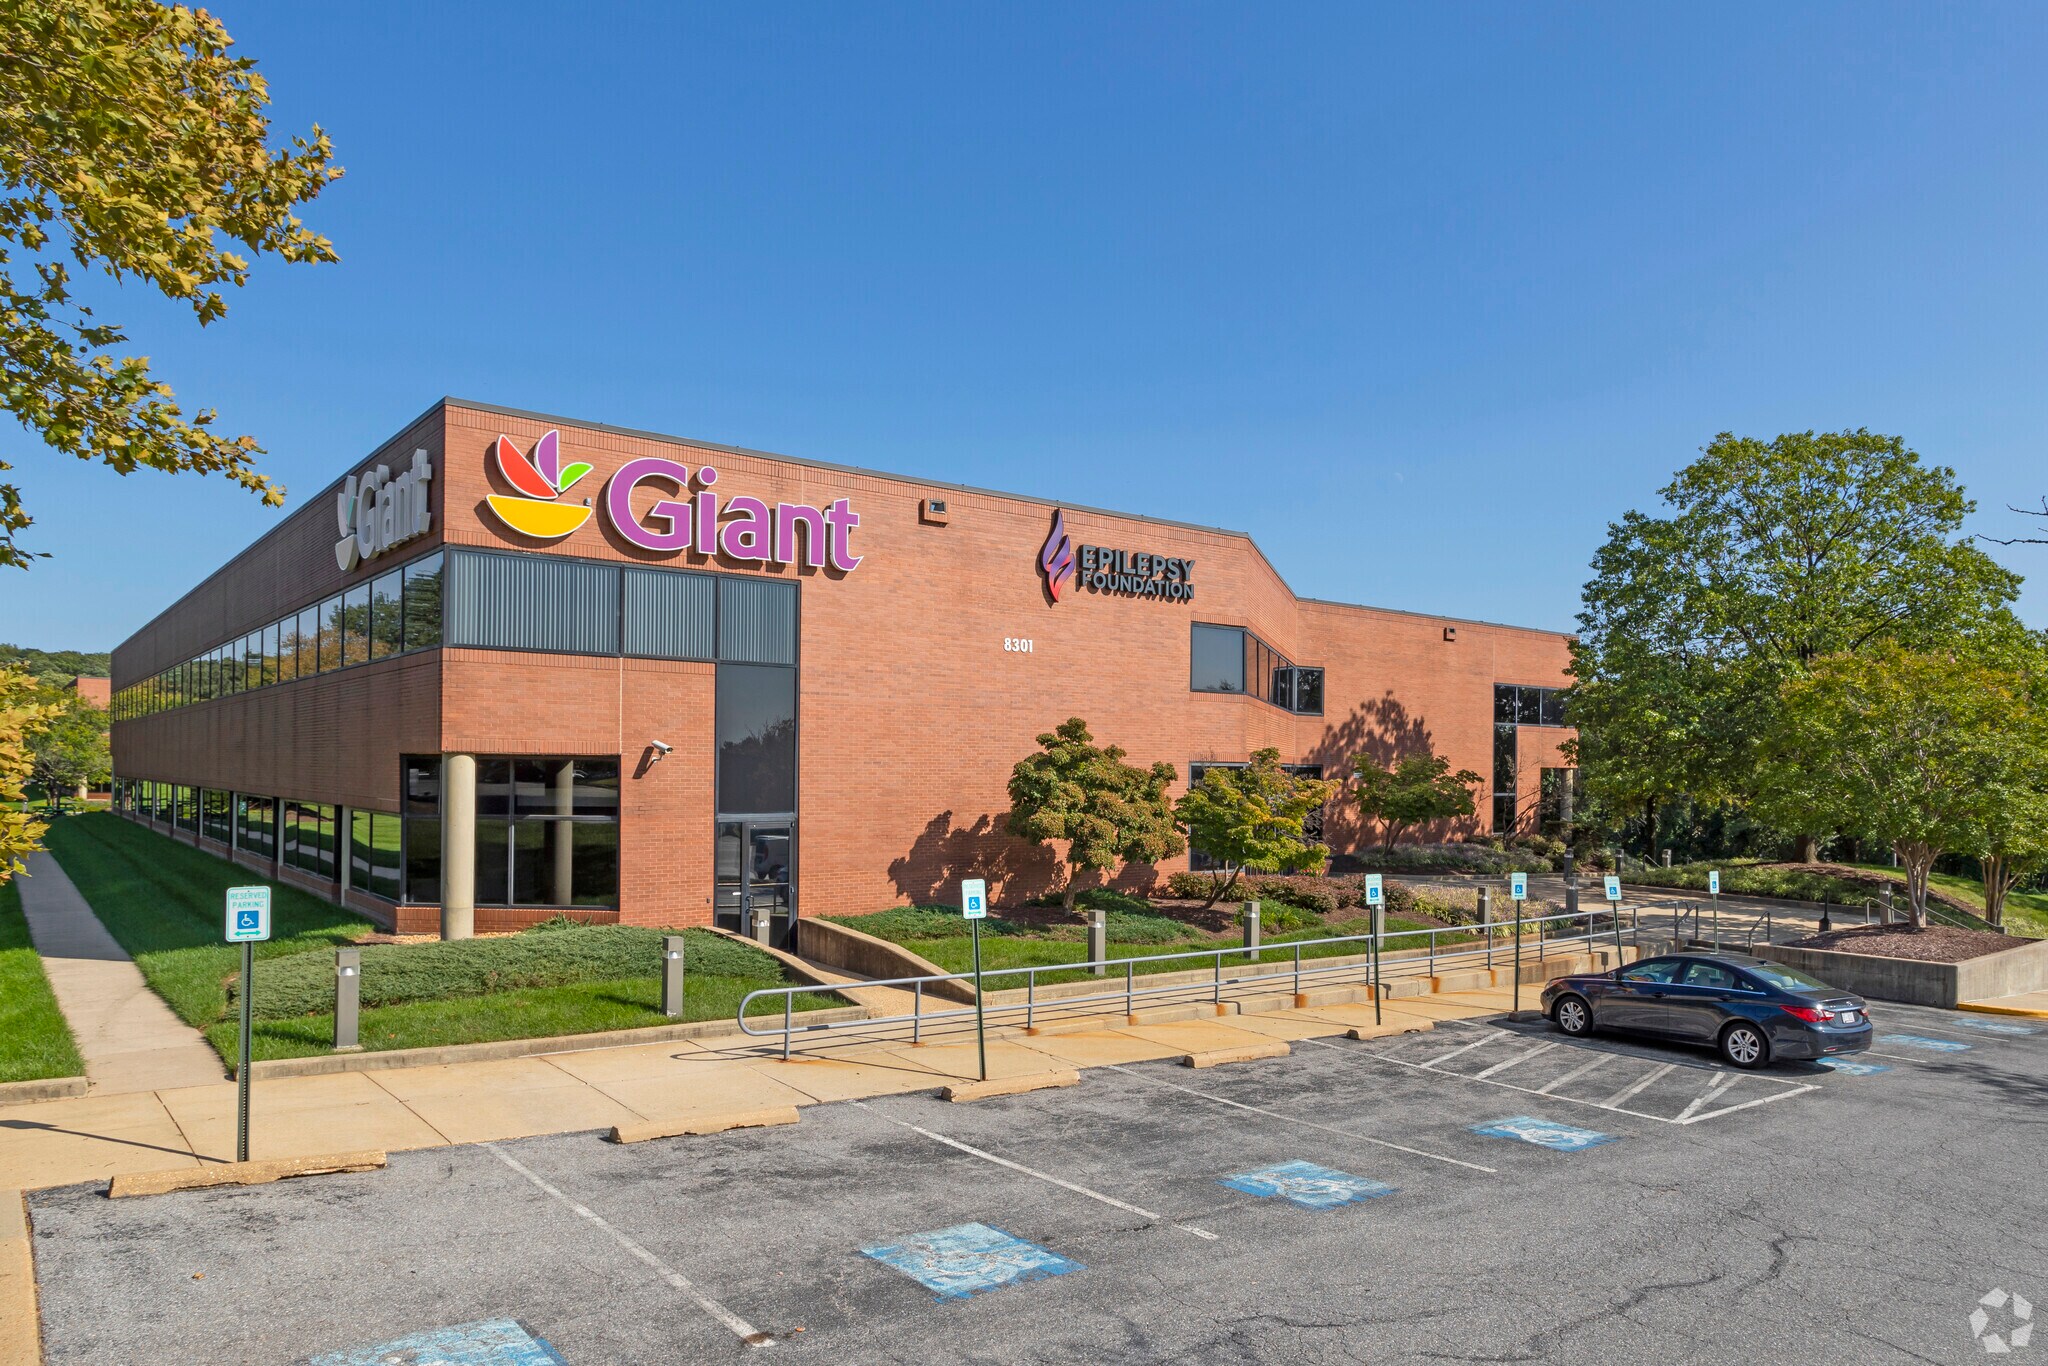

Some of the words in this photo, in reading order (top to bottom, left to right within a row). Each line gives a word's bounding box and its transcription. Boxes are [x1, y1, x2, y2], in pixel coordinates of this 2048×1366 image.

[356, 448, 432, 559] Giant
[606, 457, 864, 572] Giant
[1081, 544, 1196, 581] EPILEPSY
[1081, 570, 1195, 600] FOUNDATION
[1003, 637, 1033, 653] 8301
[230, 892, 267, 900] RESERVED
